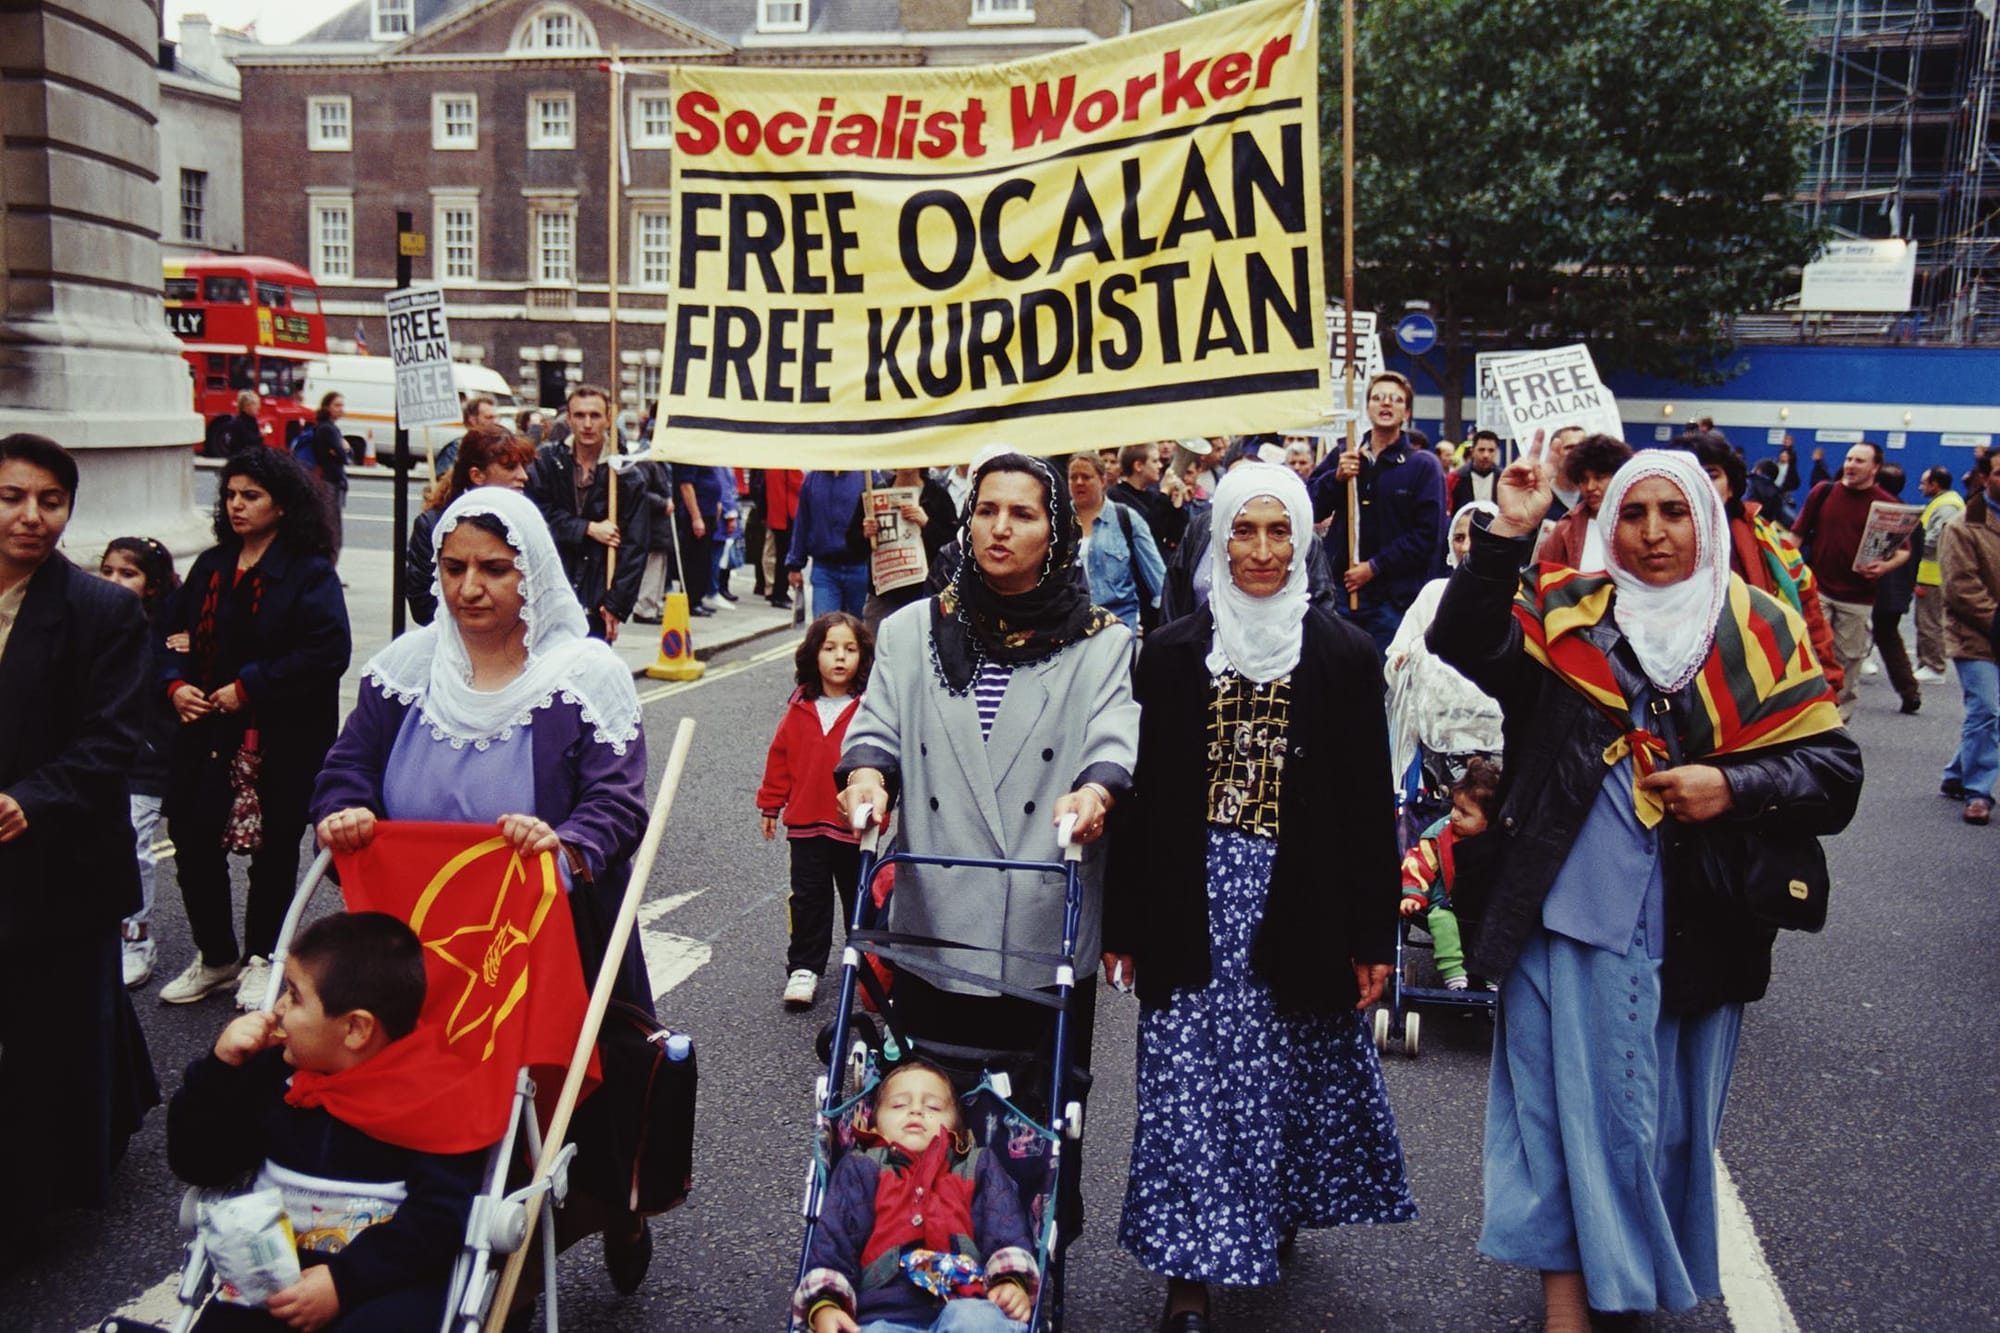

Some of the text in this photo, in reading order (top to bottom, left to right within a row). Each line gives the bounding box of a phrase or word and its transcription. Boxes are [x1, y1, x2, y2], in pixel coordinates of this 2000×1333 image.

[675, 33, 1292, 160] Socialist Worker
[678, 123, 1306, 294] FREE OCALAN
[390, 307, 445, 347] FREE
[670, 246, 1315, 403] FREE KURDISTAN
[393, 340, 448, 368] OCALAN
[1330, 331, 1369, 361] EE
[398, 365, 456, 406] FREE
[1330, 361, 1367, 381] LAN
[1503, 363, 1595, 406] FREE
[1513, 391, 1602, 424] OCALAN
